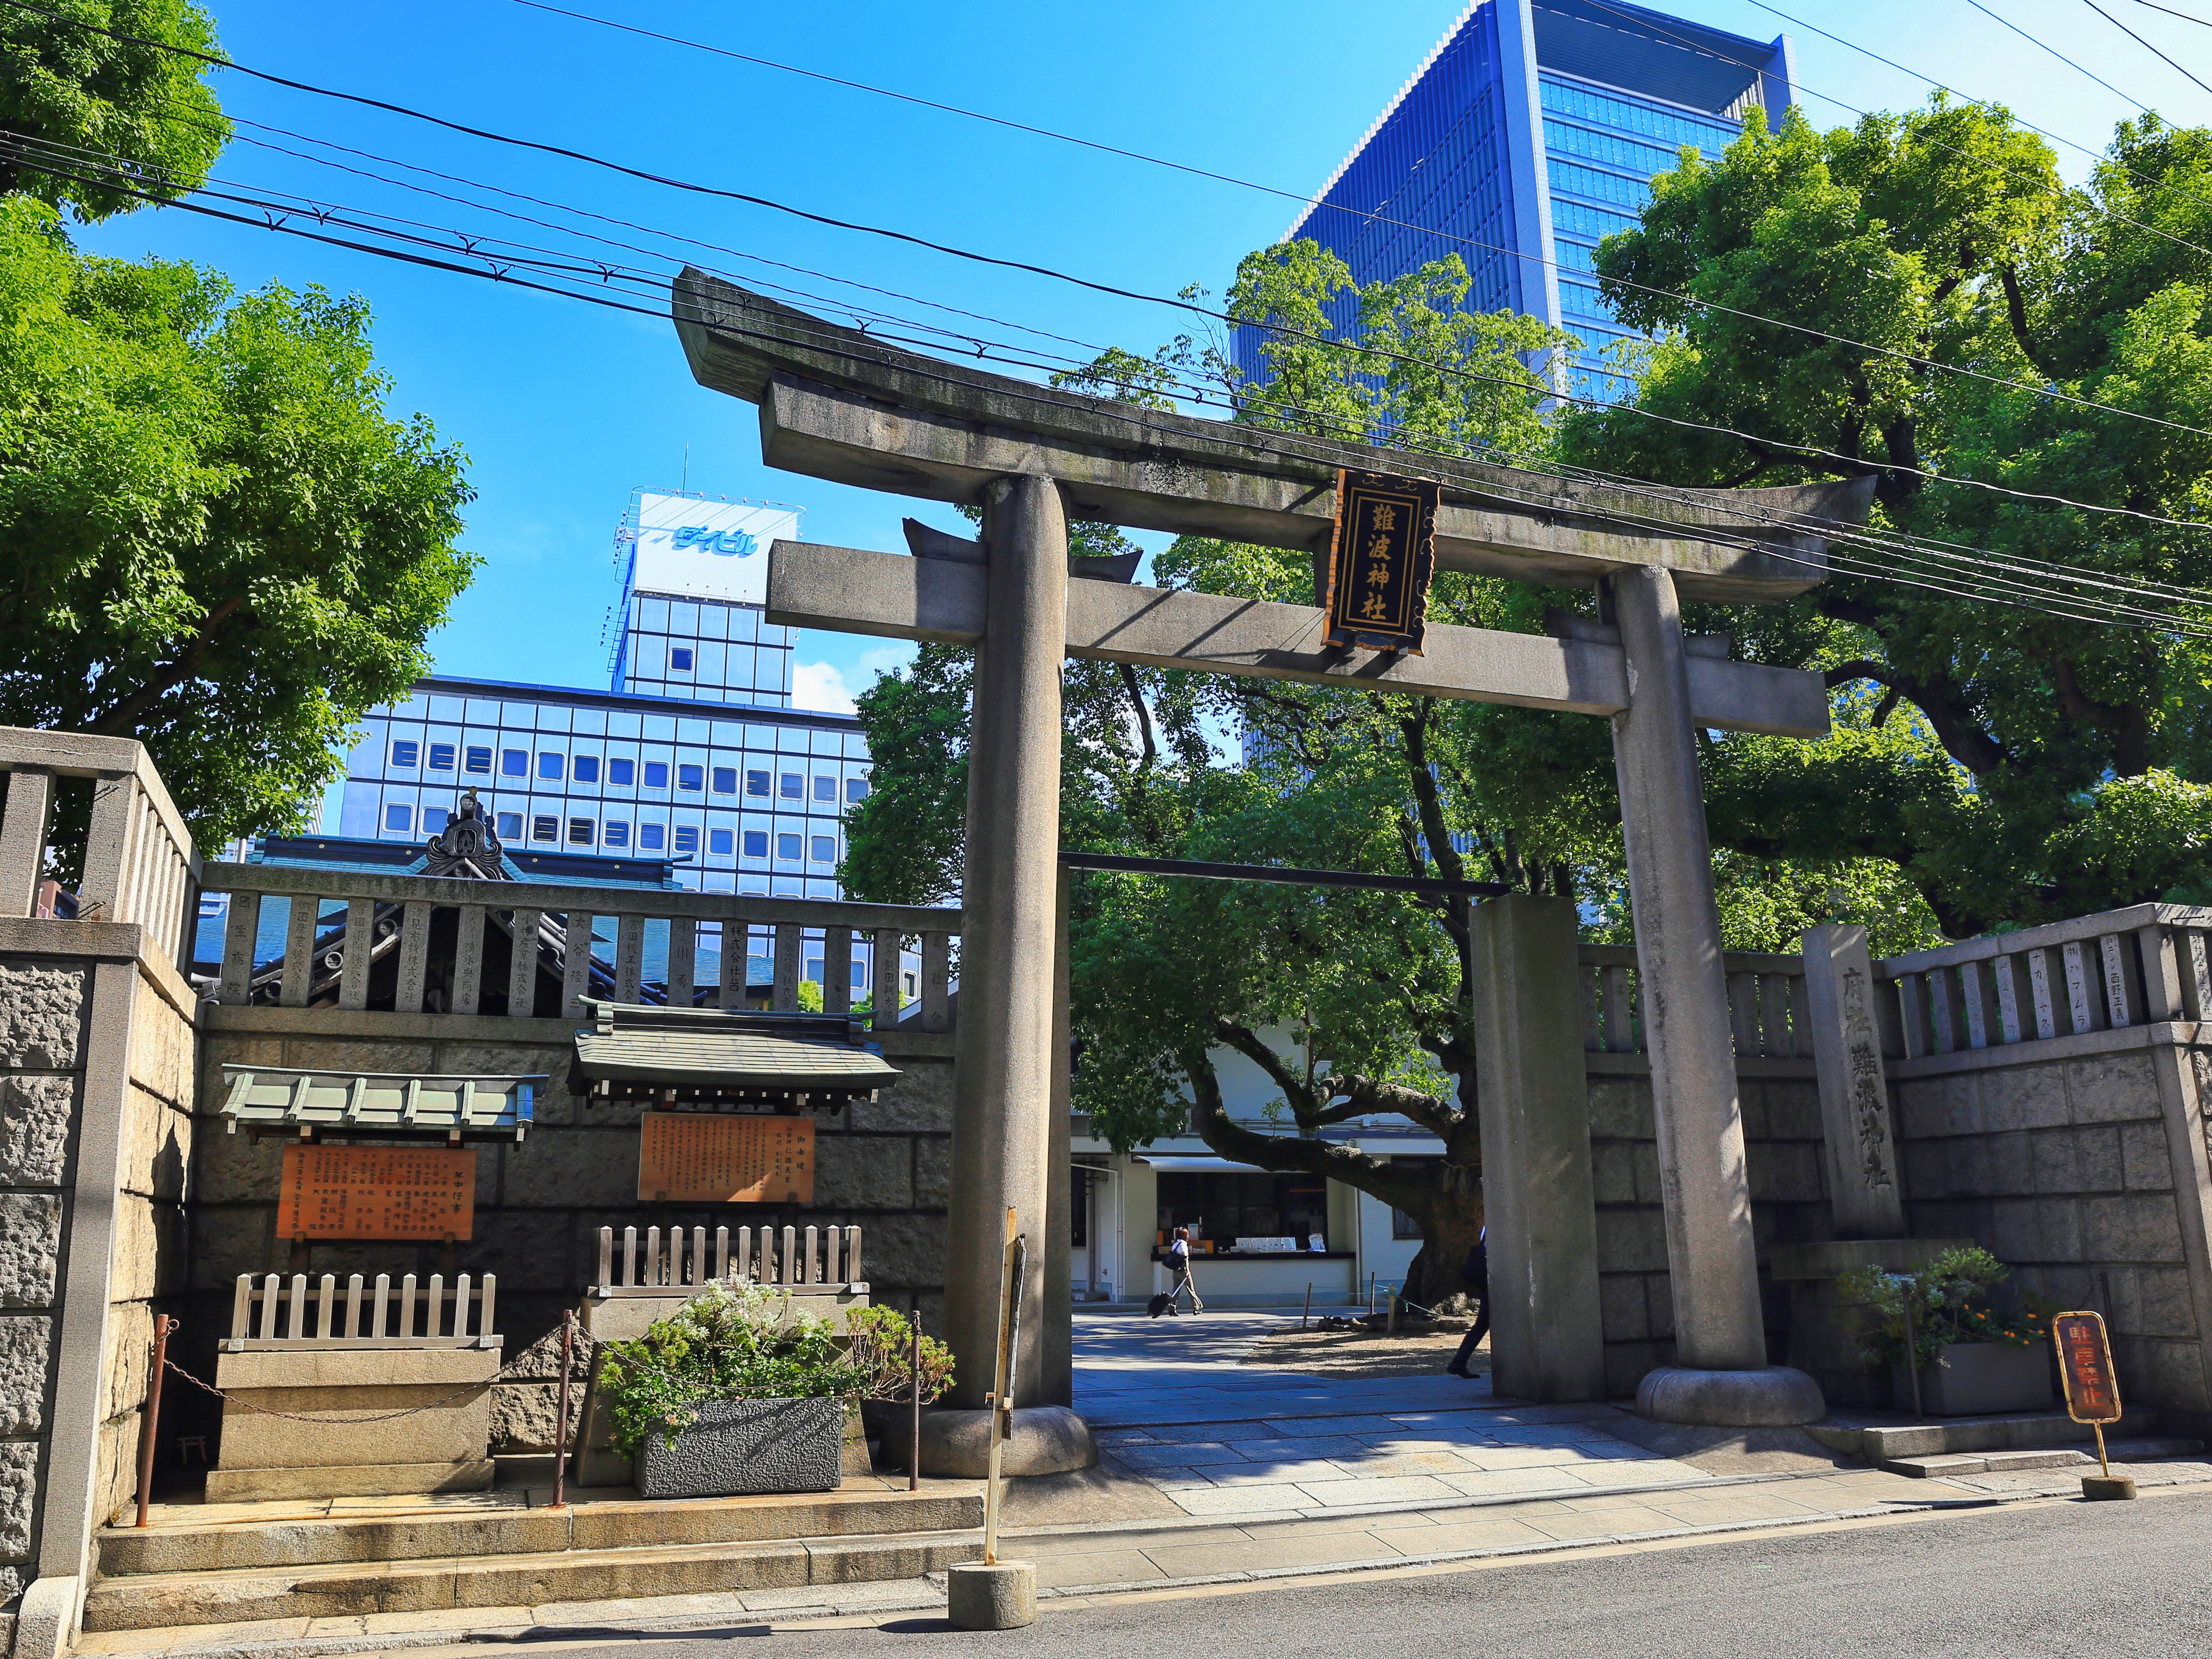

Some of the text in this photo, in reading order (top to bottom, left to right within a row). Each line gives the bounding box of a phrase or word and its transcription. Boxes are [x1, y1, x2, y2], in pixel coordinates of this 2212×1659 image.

[1360, 503, 1397, 620] 難波神社
[624, 920, 638, 1003] 富田機工株式会
[451, 1171, 464, 1215] 年中行事
[796, 1136, 805, 1170] 御由緒
[2069, 1326, 2103, 1406] 駐車禁止
